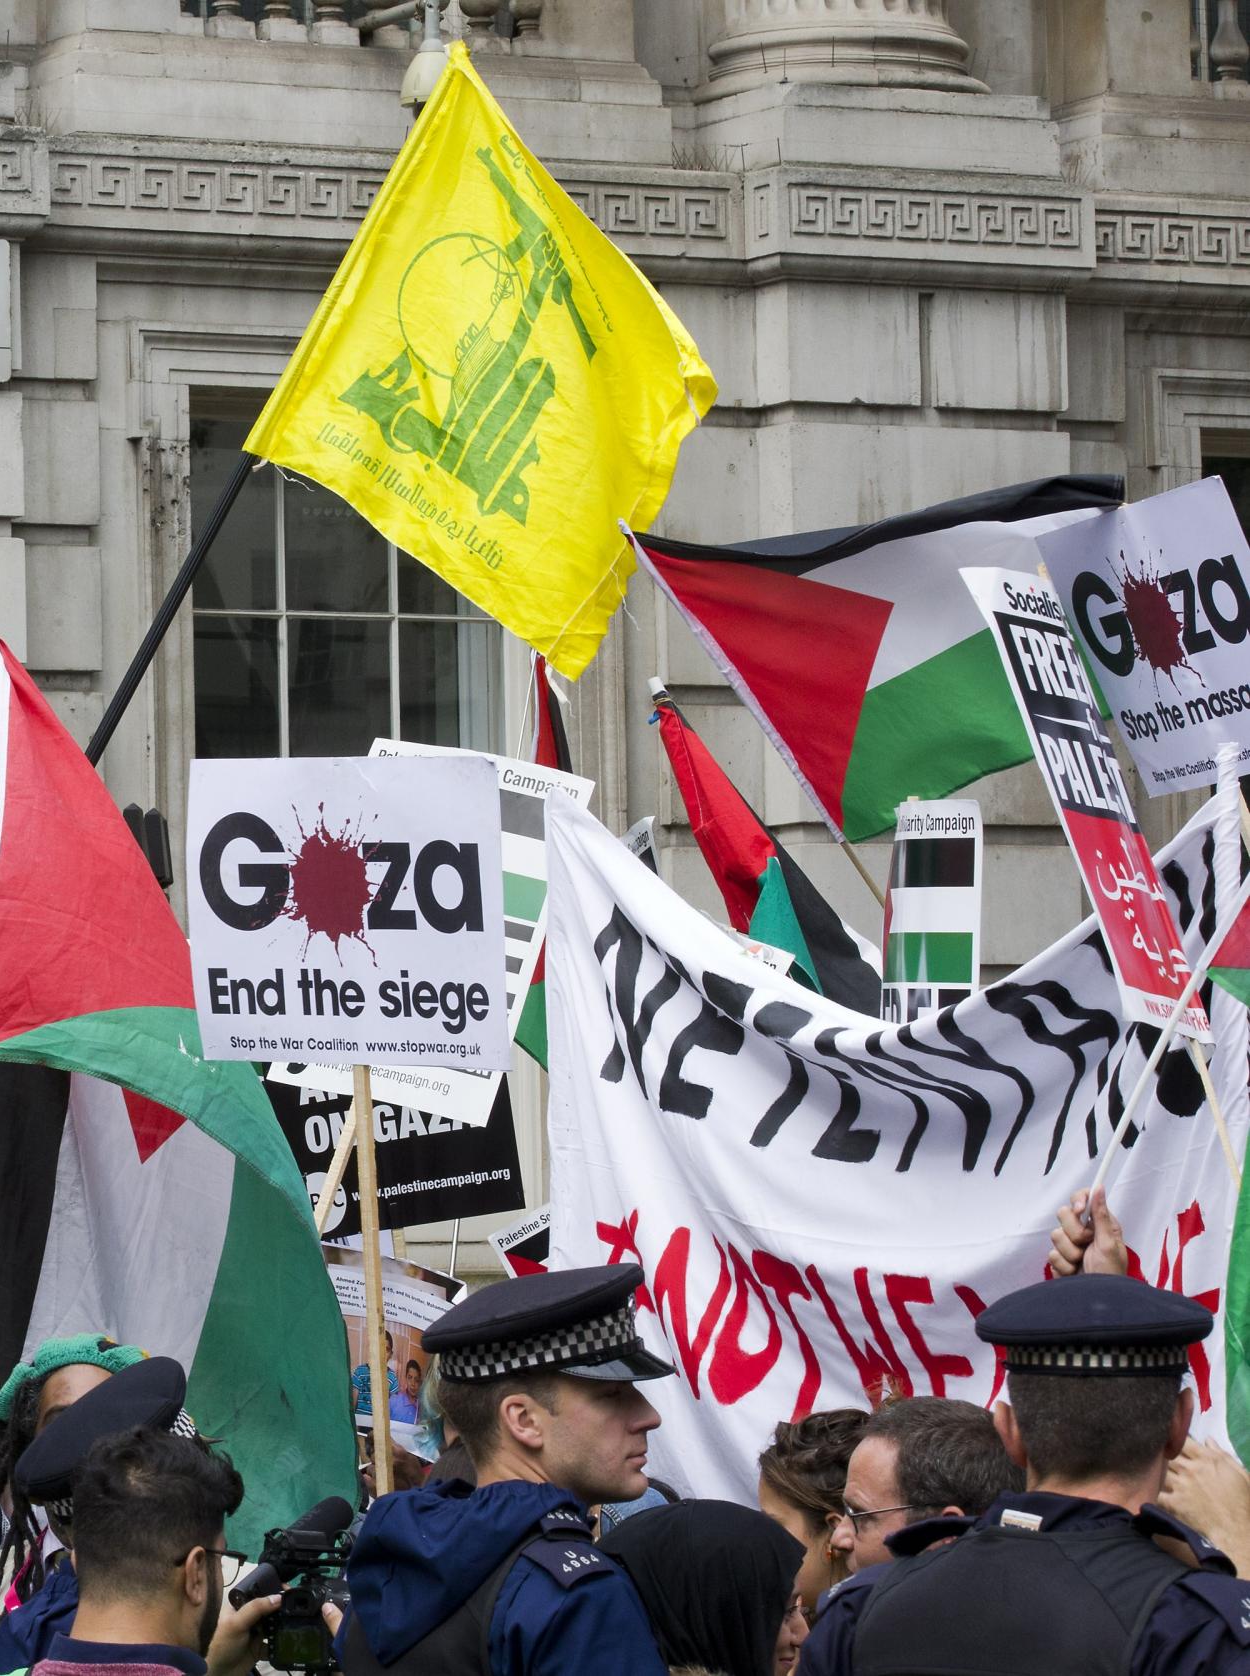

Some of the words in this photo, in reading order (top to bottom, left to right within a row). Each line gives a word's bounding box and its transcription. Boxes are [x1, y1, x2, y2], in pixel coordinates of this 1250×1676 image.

[1003, 581, 1065, 622] Socialis
[1121, 708, 1159, 743] Stop
[1154, 700, 1186, 732] the
[1184, 684, 1250, 726] mass
[1152, 770, 1166, 783] Stop
[1165, 768, 1175, 780] the
[1174, 766, 1186, 778] War
[1186, 756, 1217, 776] Coalition
[926, 813, 975, 835] Campaign
[207, 967, 286, 1016] End
[297, 968, 366, 1018] the
[378, 969, 490, 1035] siege
[230, 1035, 255, 1051] Stop
[259, 1036, 278, 1050] the
[280, 1036, 304, 1050] War
[307, 1037, 358, 1052] Coalition
[365, 1039, 481, 1057] www.stopwar.org.uk
[497, 1219, 540, 1248] Palestine
[336, 1284, 350, 1292] aged
[384, 1301, 397, 1309] 2014,
[385, 1309, 398, 1317] Gaza
[562, 1554, 599, 1573] 4964
[564, 1550, 577, 1559] U
